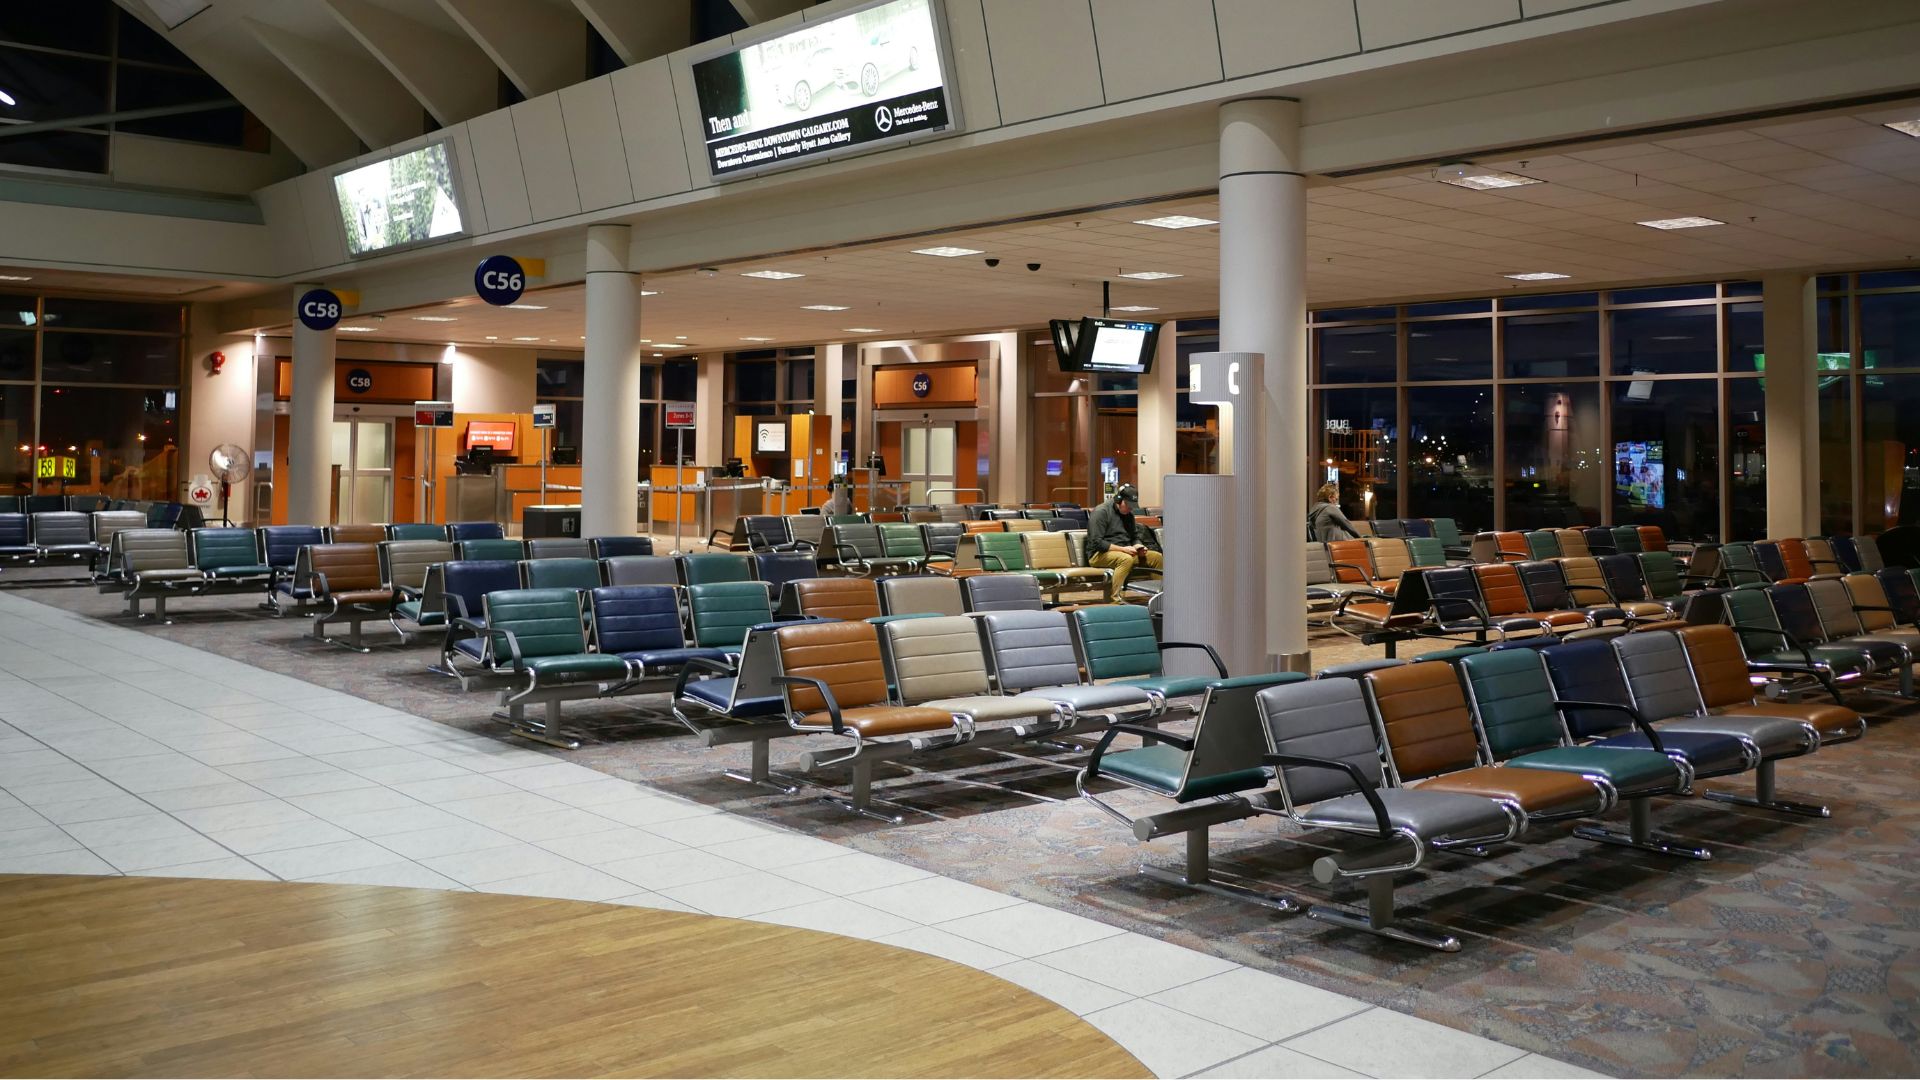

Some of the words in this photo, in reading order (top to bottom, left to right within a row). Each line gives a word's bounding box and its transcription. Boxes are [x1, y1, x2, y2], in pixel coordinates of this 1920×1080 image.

[893, 101, 939, 118] Mercedes-Benz
[709, 117, 732, 134] Then
[732, 109, 751, 130] and
[714, 138, 763, 158] MERCEDES-BENZ
[763, 128, 802, 148] DOWNTOWN
[801, 118, 850, 138] CALGARY.COM
[717, 155, 743, 169] Downtown
[742, 150, 774, 164] Convenience
[777, 142, 801, 156] Formerly
[800, 138, 817, 152] Hyatt
[817, 135, 831, 147] Auto
[829, 132, 852, 145] Gallery
[482, 270, 523, 291] C56
[303, 301, 340, 319] C58
[350, 376, 371, 388] C58
[913, 381, 927, 391] C56
[41, 459, 53, 476] 58
[66, 459, 74, 476] 58
